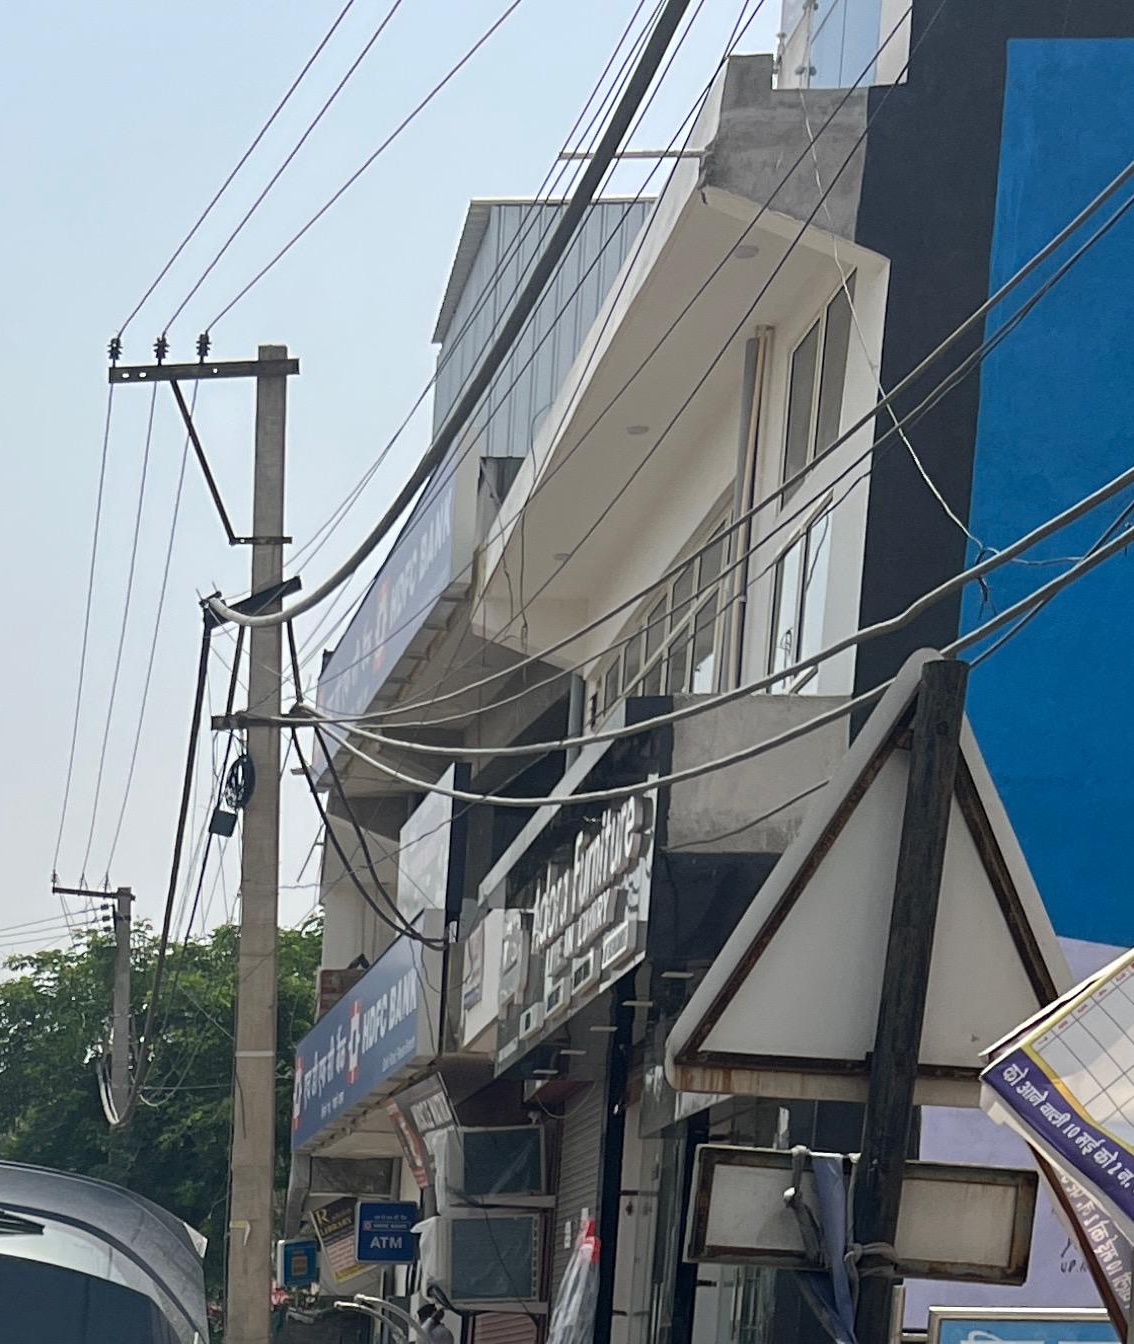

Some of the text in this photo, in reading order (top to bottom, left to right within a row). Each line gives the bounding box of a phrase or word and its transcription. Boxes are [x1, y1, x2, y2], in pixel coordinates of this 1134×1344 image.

[362, 993, 388, 1054] HDFC
[388, 966, 417, 1031] BANK
[1062, 1122, 1080, 1139] 10
[370, 1236, 403, 1249] ATM
